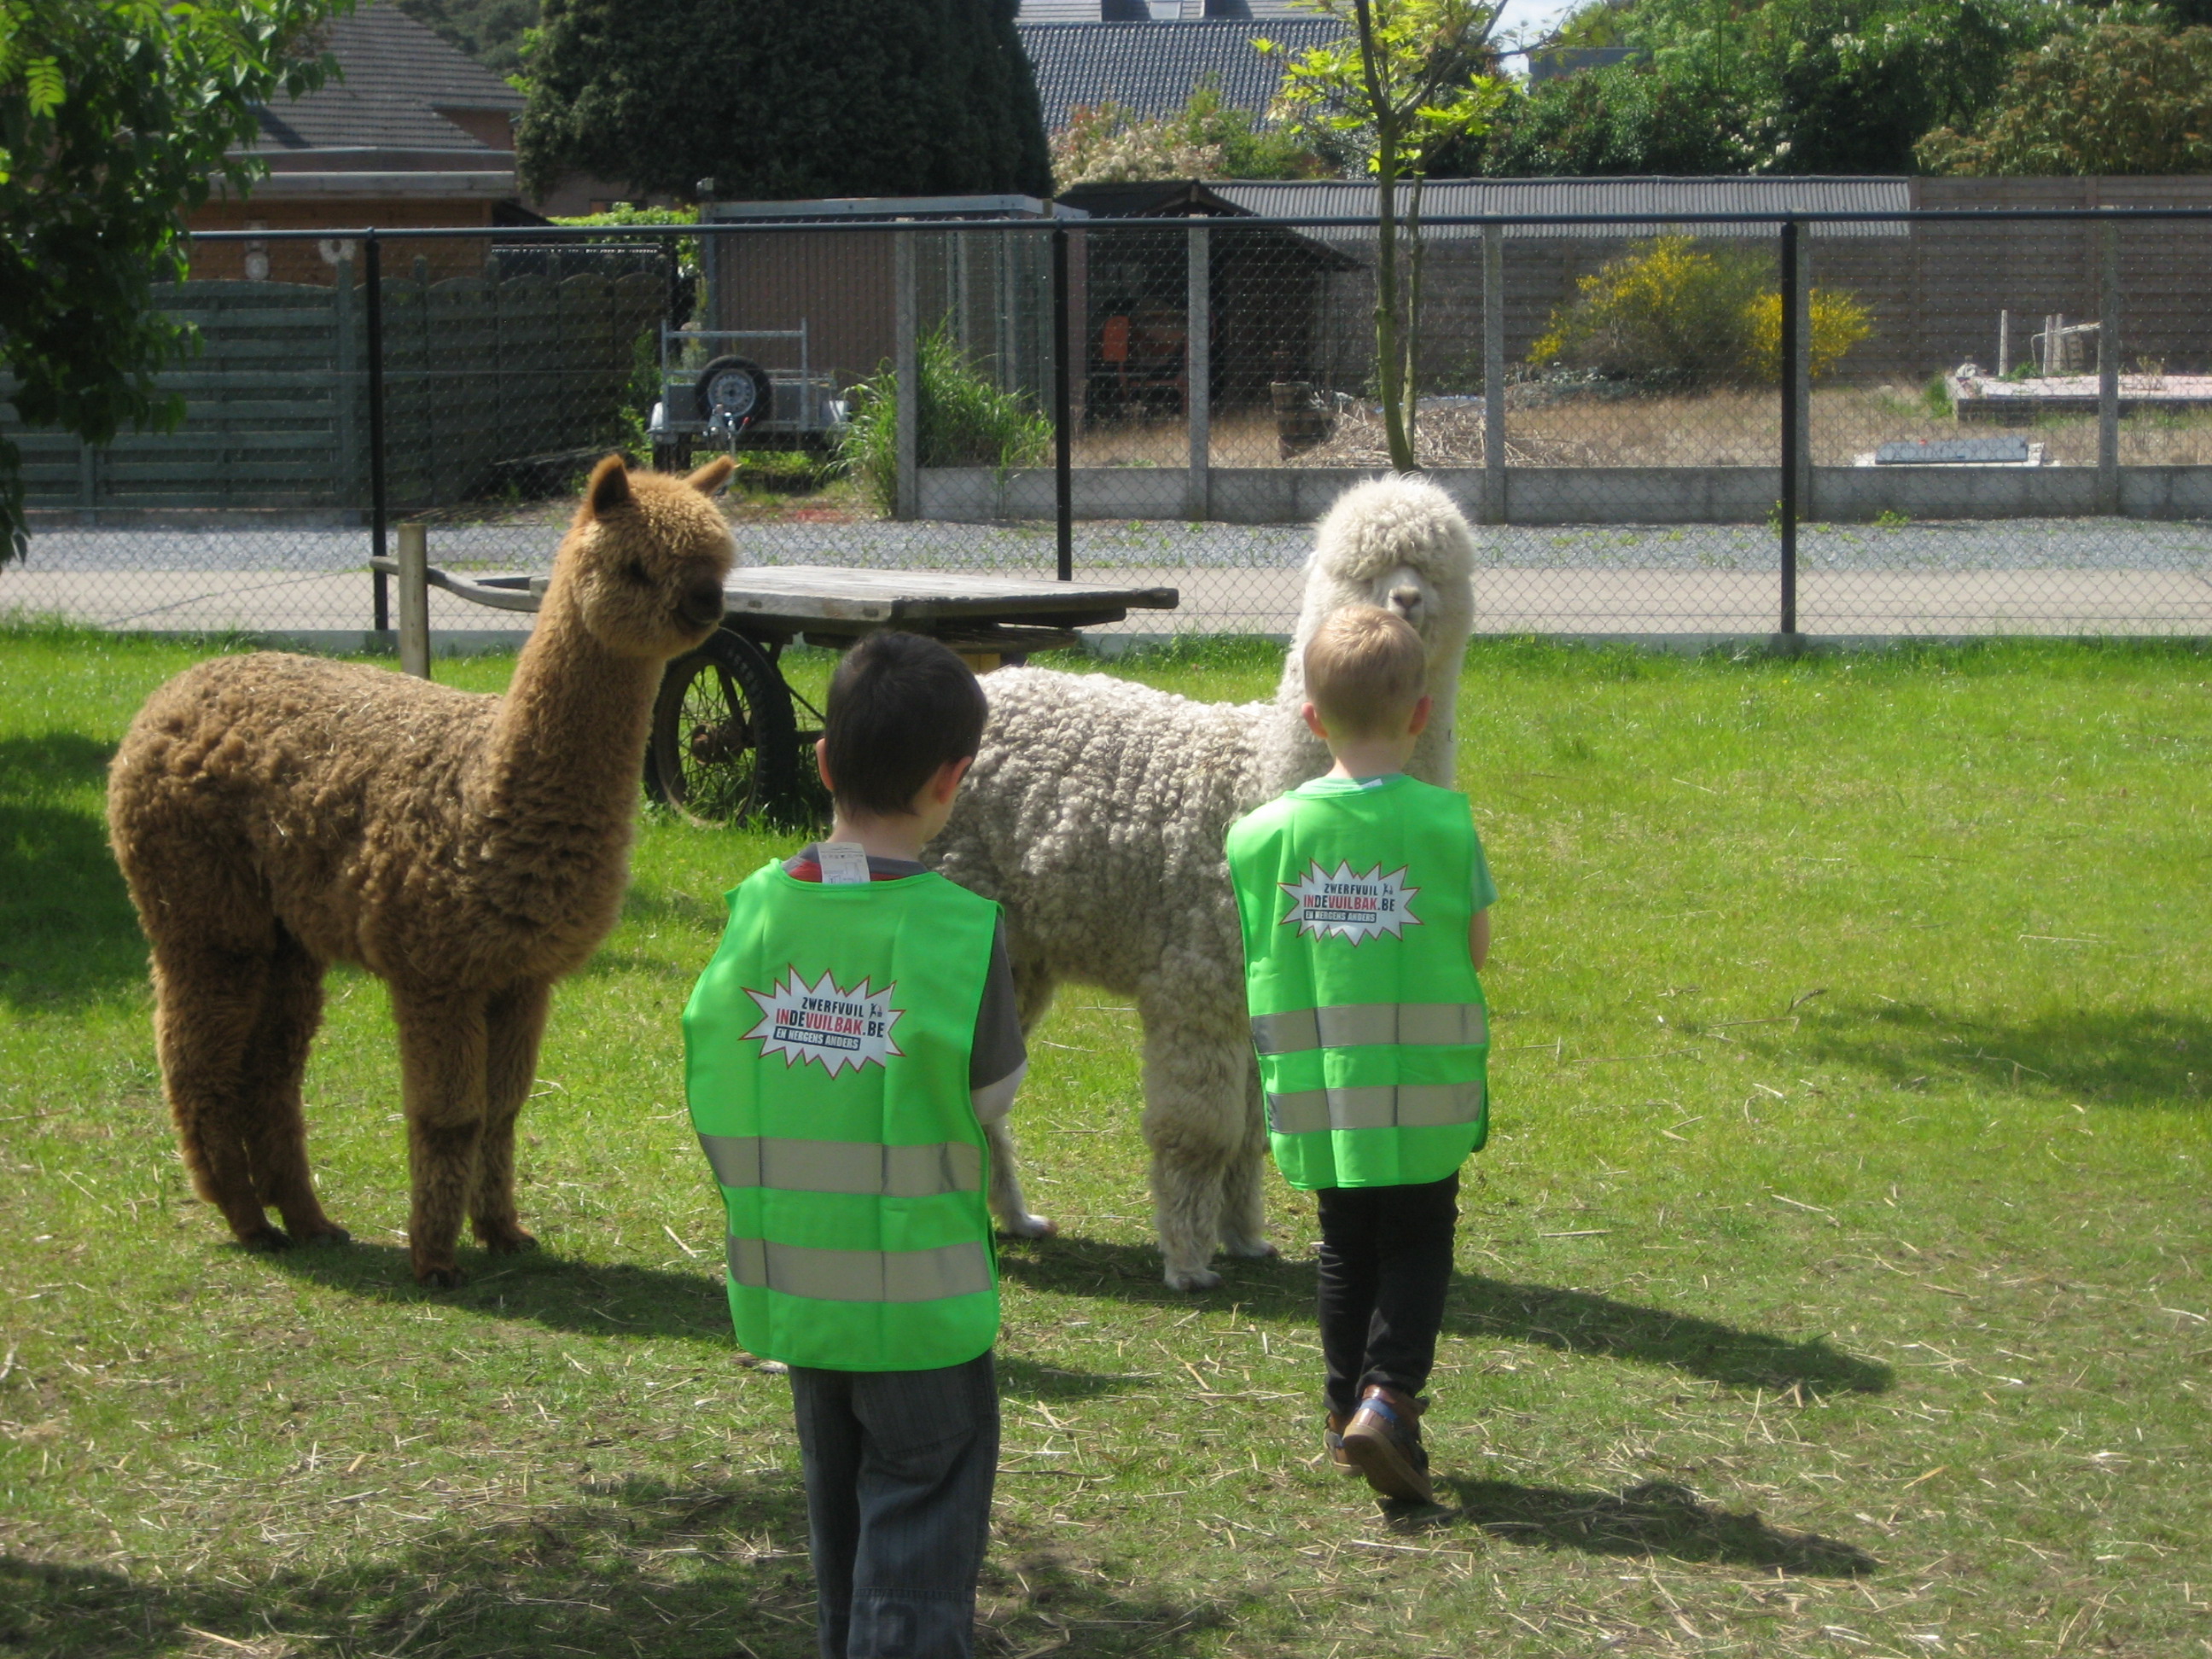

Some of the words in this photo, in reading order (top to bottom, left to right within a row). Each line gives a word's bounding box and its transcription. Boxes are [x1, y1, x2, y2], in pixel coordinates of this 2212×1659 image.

[1324, 883, 1377, 895] ZWERFVUIL
[1304, 895, 1395, 911] INDEVUILBAK.BE
[801, 997, 864, 1017] ZWERFVUIL
[776, 1008, 885, 1038] INDEVUILBAK.BE
[777, 1027, 787, 1039] EN
[789, 1029, 824, 1045] NERGENS
[824, 1035, 859, 1050] ANDERS
